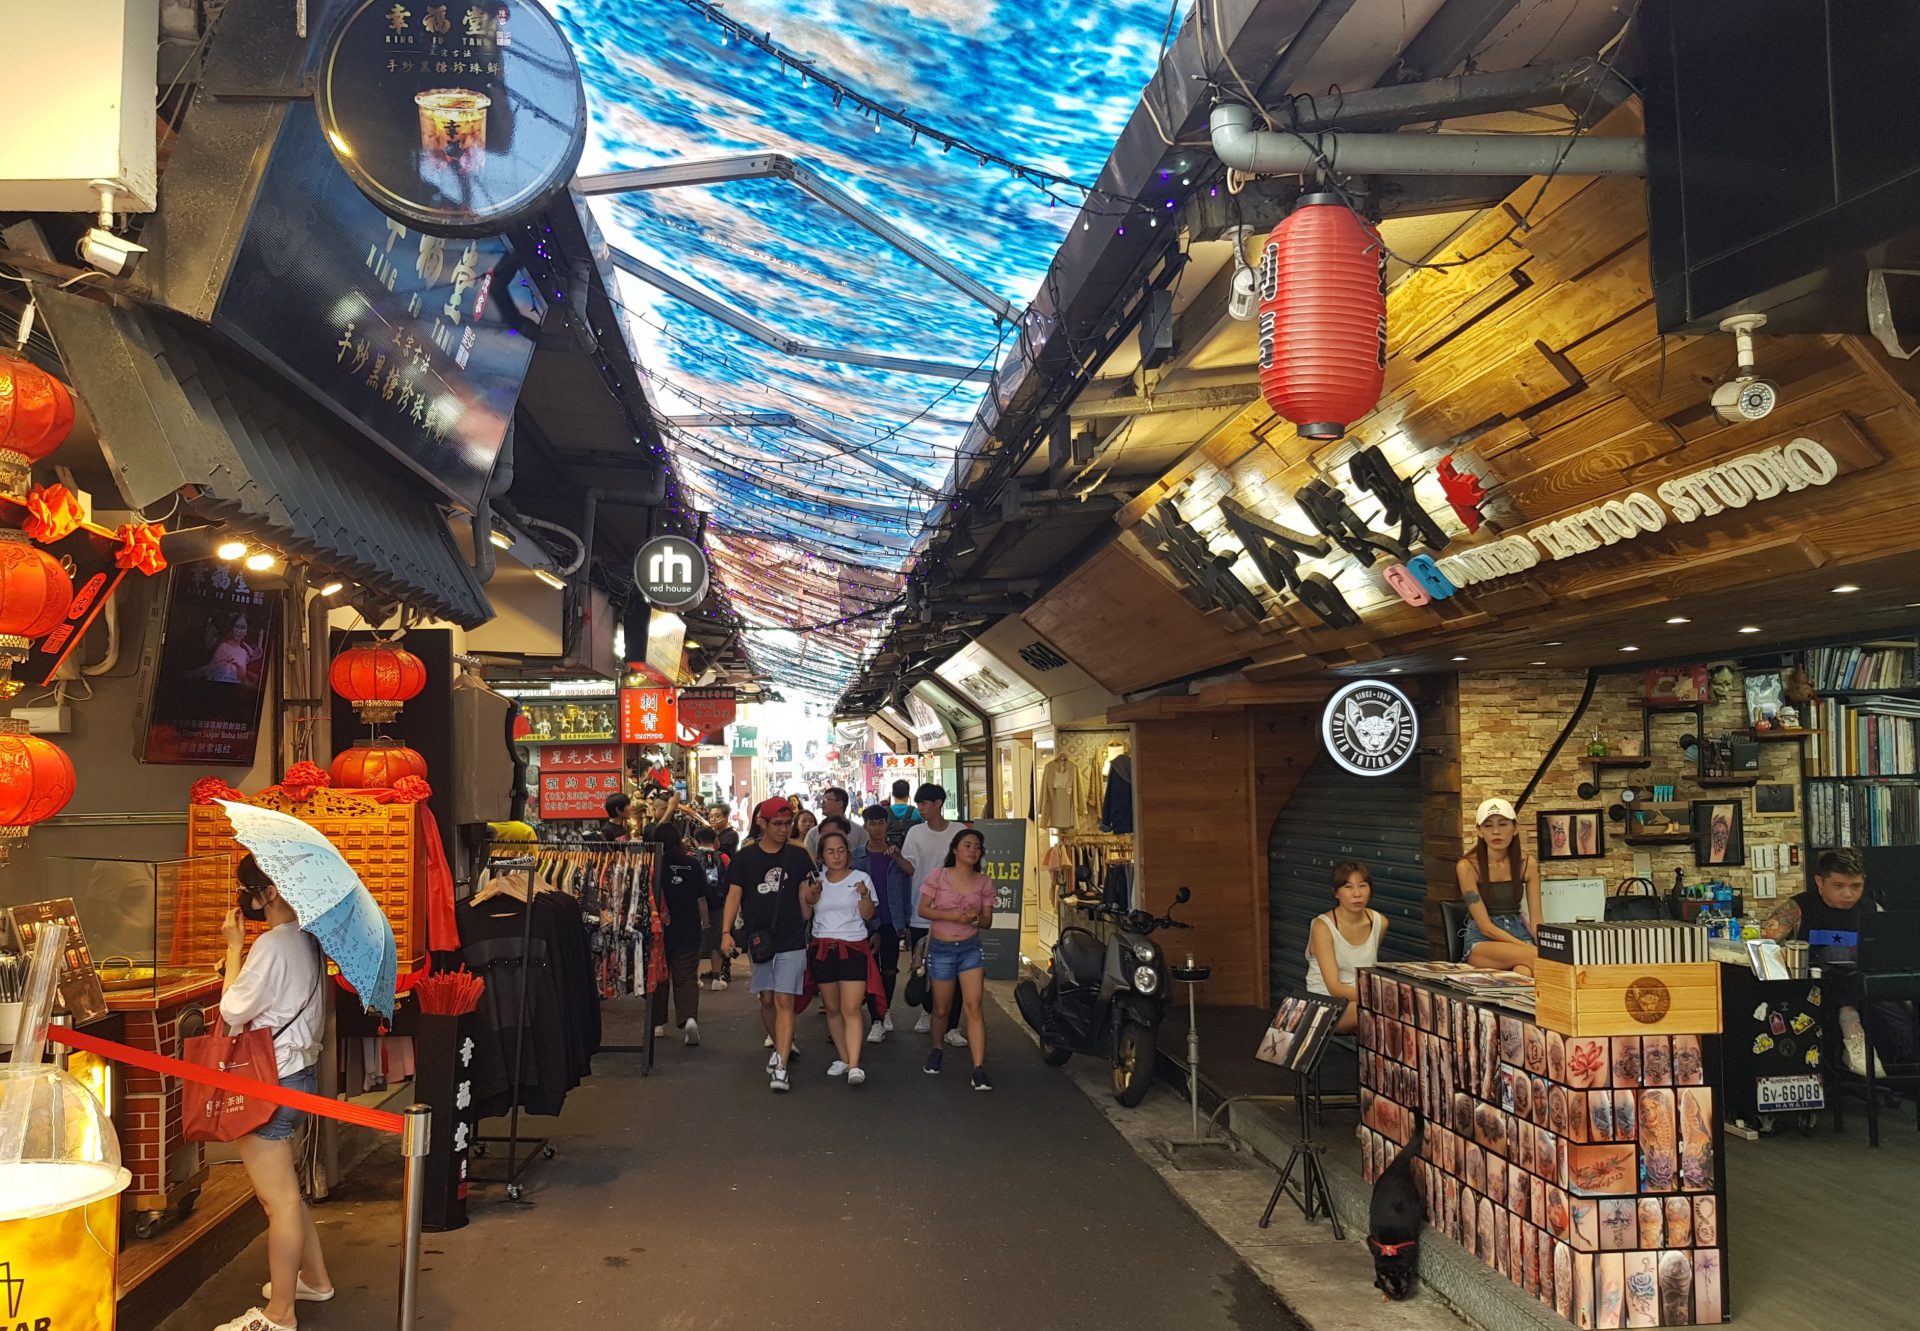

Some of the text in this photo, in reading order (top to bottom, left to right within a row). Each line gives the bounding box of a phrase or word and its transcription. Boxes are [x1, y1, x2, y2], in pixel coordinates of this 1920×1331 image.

[384, 3, 488, 36] 幸福堂
[1434, 437, 1839, 590] UNITED TATTOO STUDIO
[649, 546, 692, 584] rh
[649, 583, 692, 593] red house
[640, 692, 659, 731] 刺青
[1332, 712, 1350, 753] UNITED
[1393, 715, 1412, 756] STUDIO
[550, 749, 616, 765] 星光大道
[1350, 752, 1392, 768] TATTOO
[545, 776, 619, 790] 預約專線
[981, 862, 1021, 880] ALE
[1762, 1084, 1820, 1102] 6V-66088
